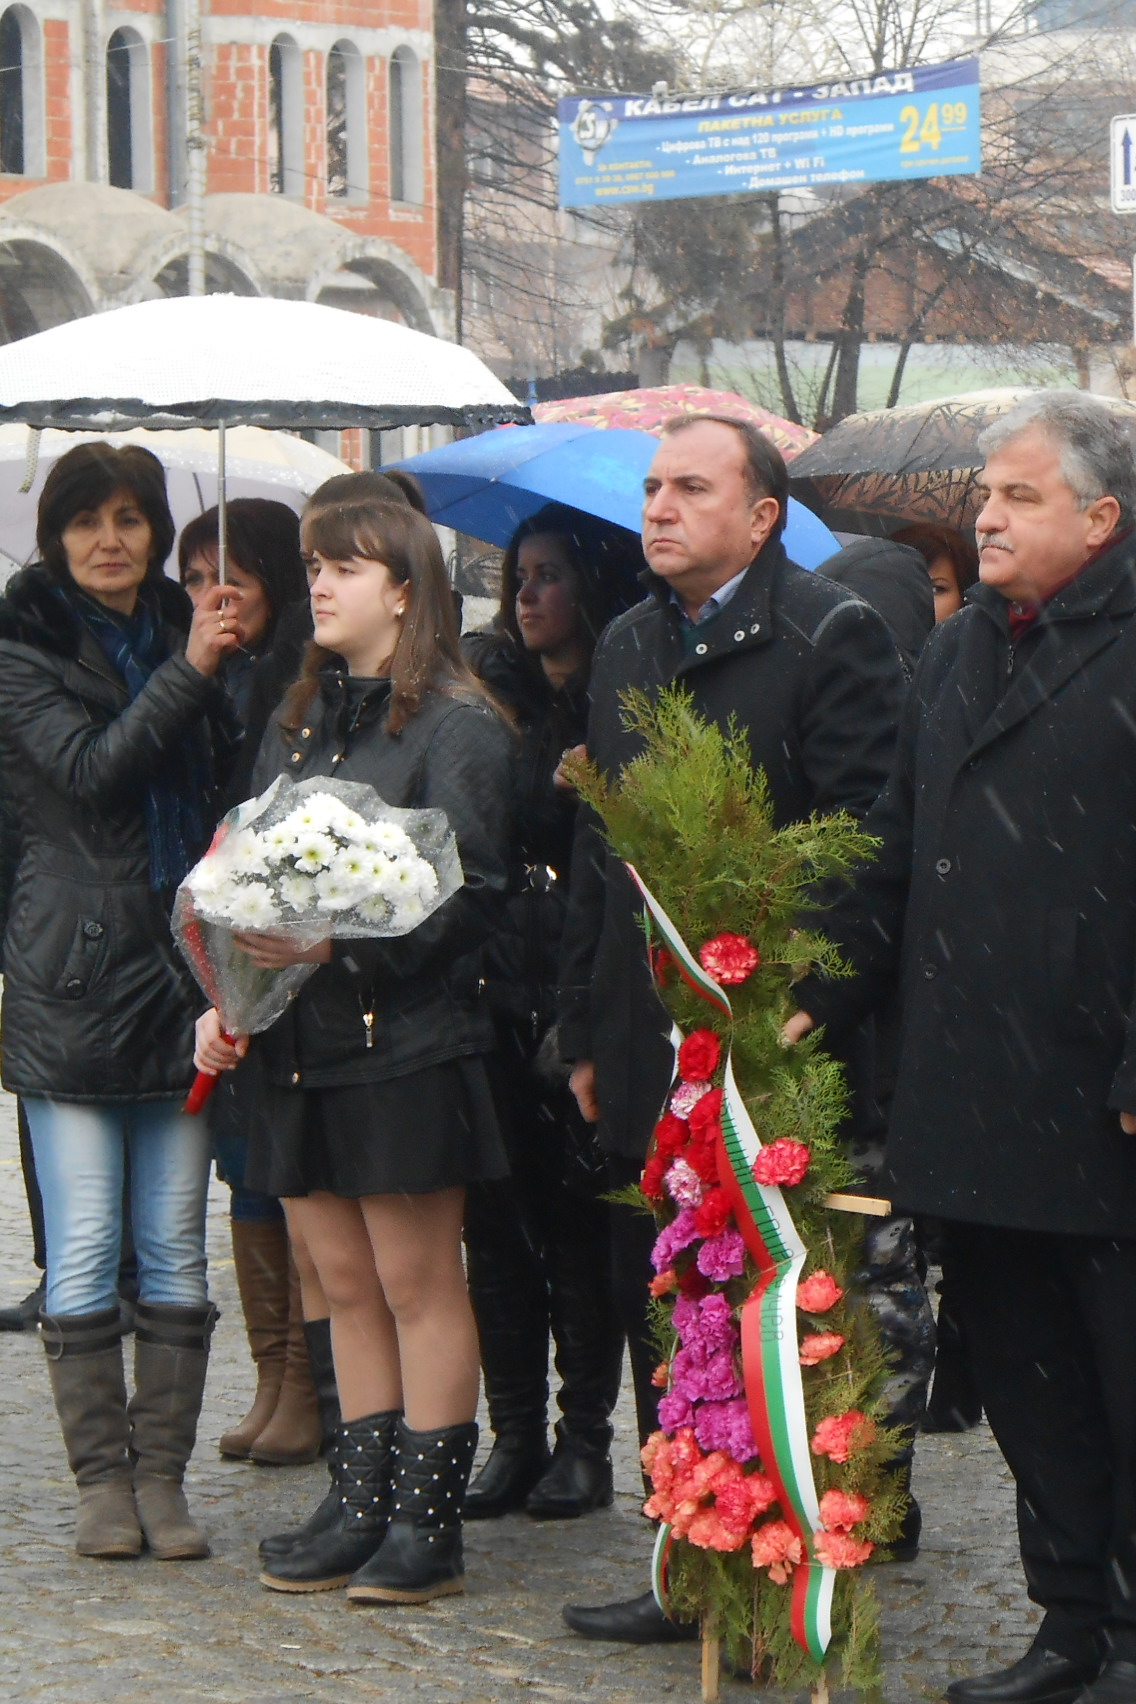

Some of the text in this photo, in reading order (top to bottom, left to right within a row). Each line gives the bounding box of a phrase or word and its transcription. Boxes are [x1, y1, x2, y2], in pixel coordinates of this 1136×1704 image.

[697, 108, 844, 132] ПАКЕТНА УСЛУГА
[752, 132, 770, 145] 120
[759, 147, 777, 159] ТВ
